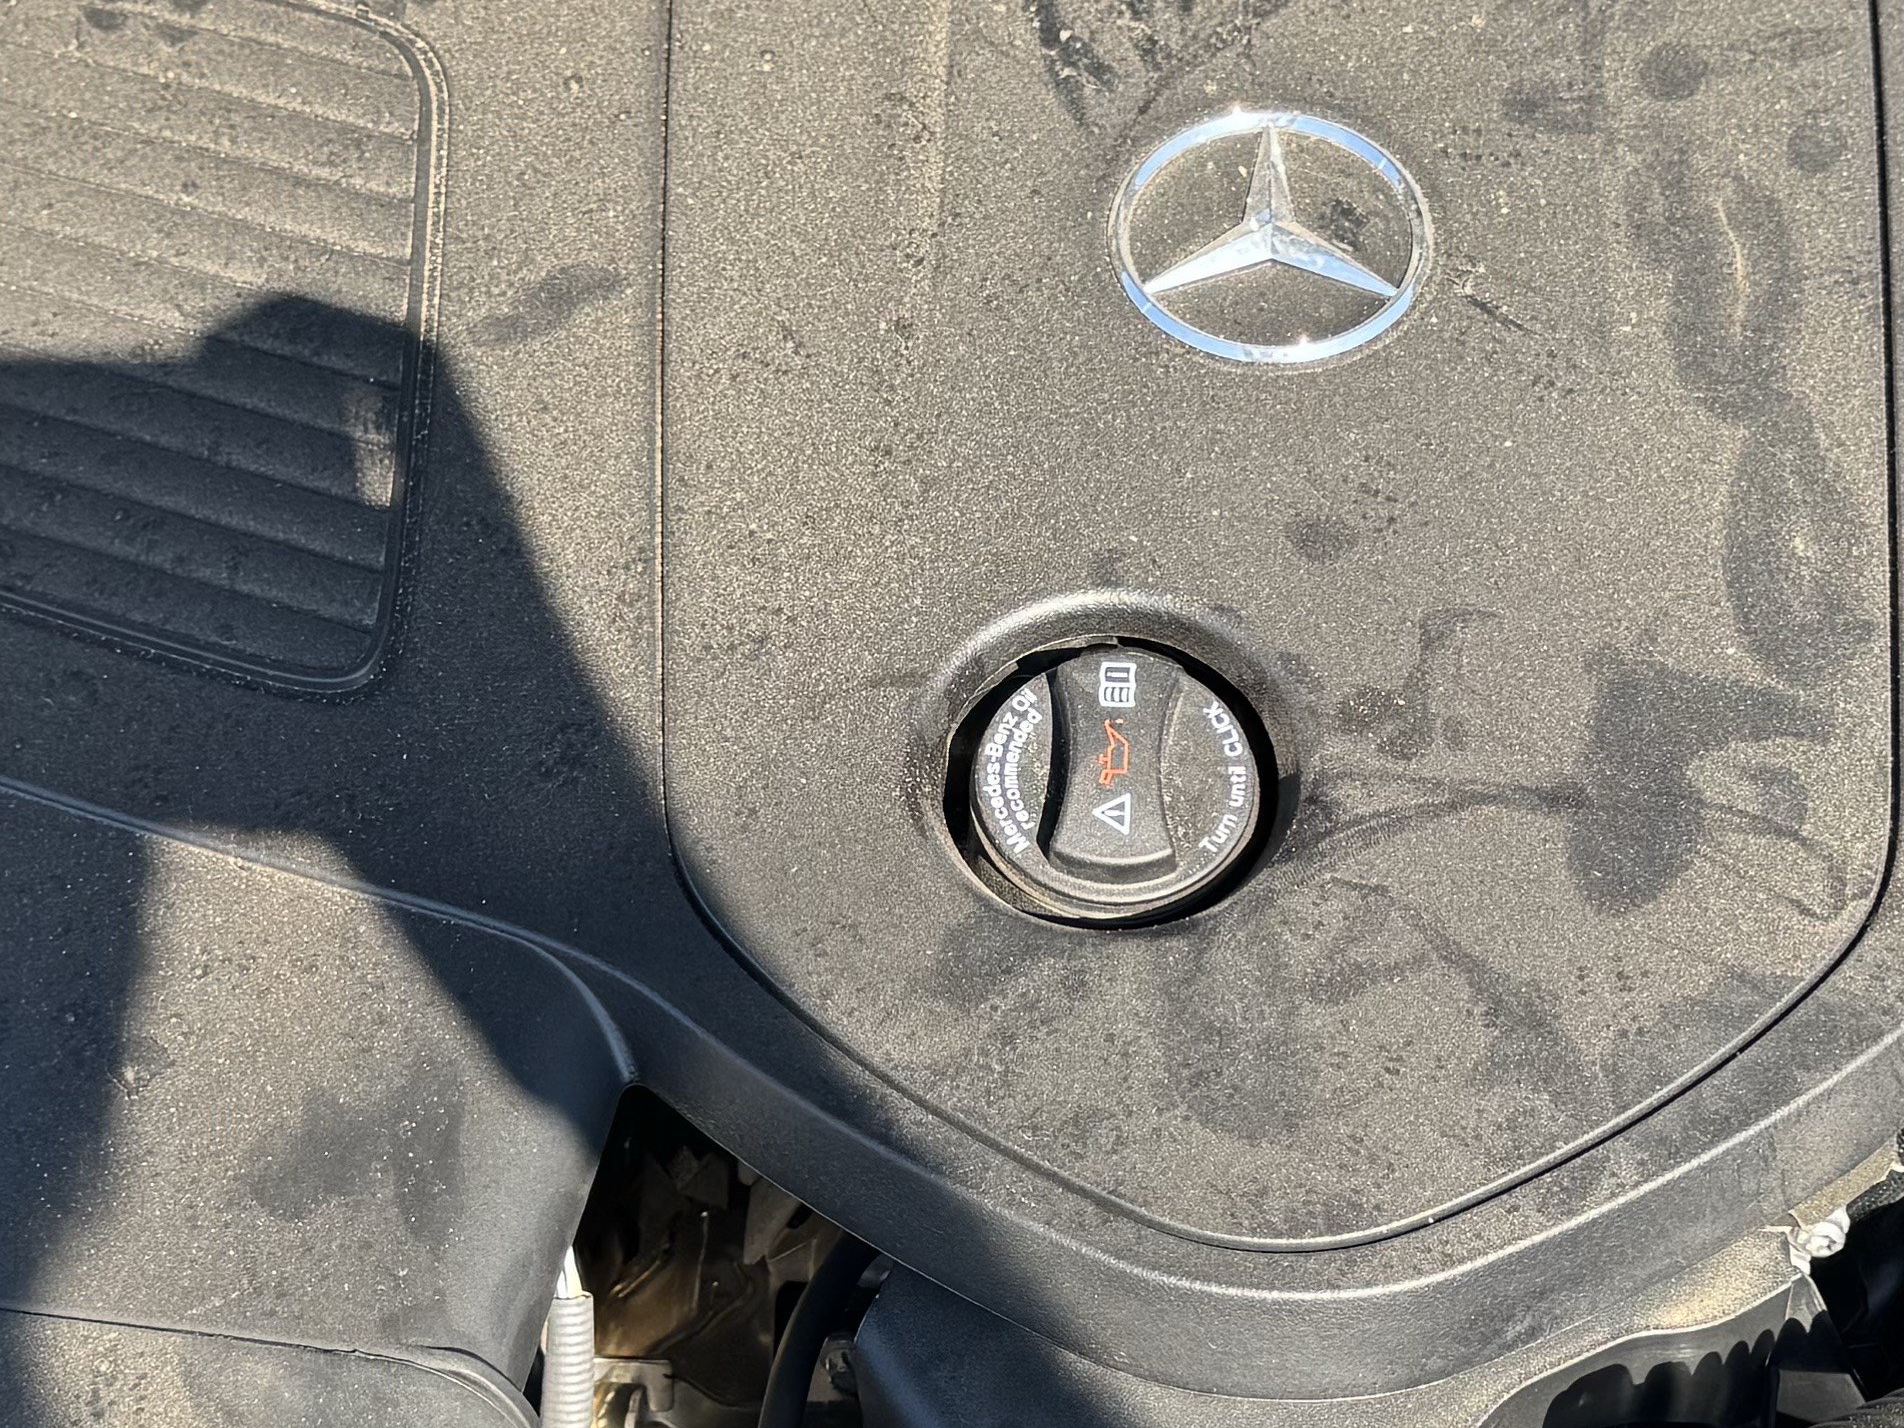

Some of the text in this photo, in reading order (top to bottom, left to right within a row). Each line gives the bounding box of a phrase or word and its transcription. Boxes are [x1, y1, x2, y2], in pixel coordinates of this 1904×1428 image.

[983, 687, 1038, 854] Mercedes-Benz Oil
[1003, 707, 1043, 831] recommended
[1198, 700, 1246, 853] Turn until CLICK
